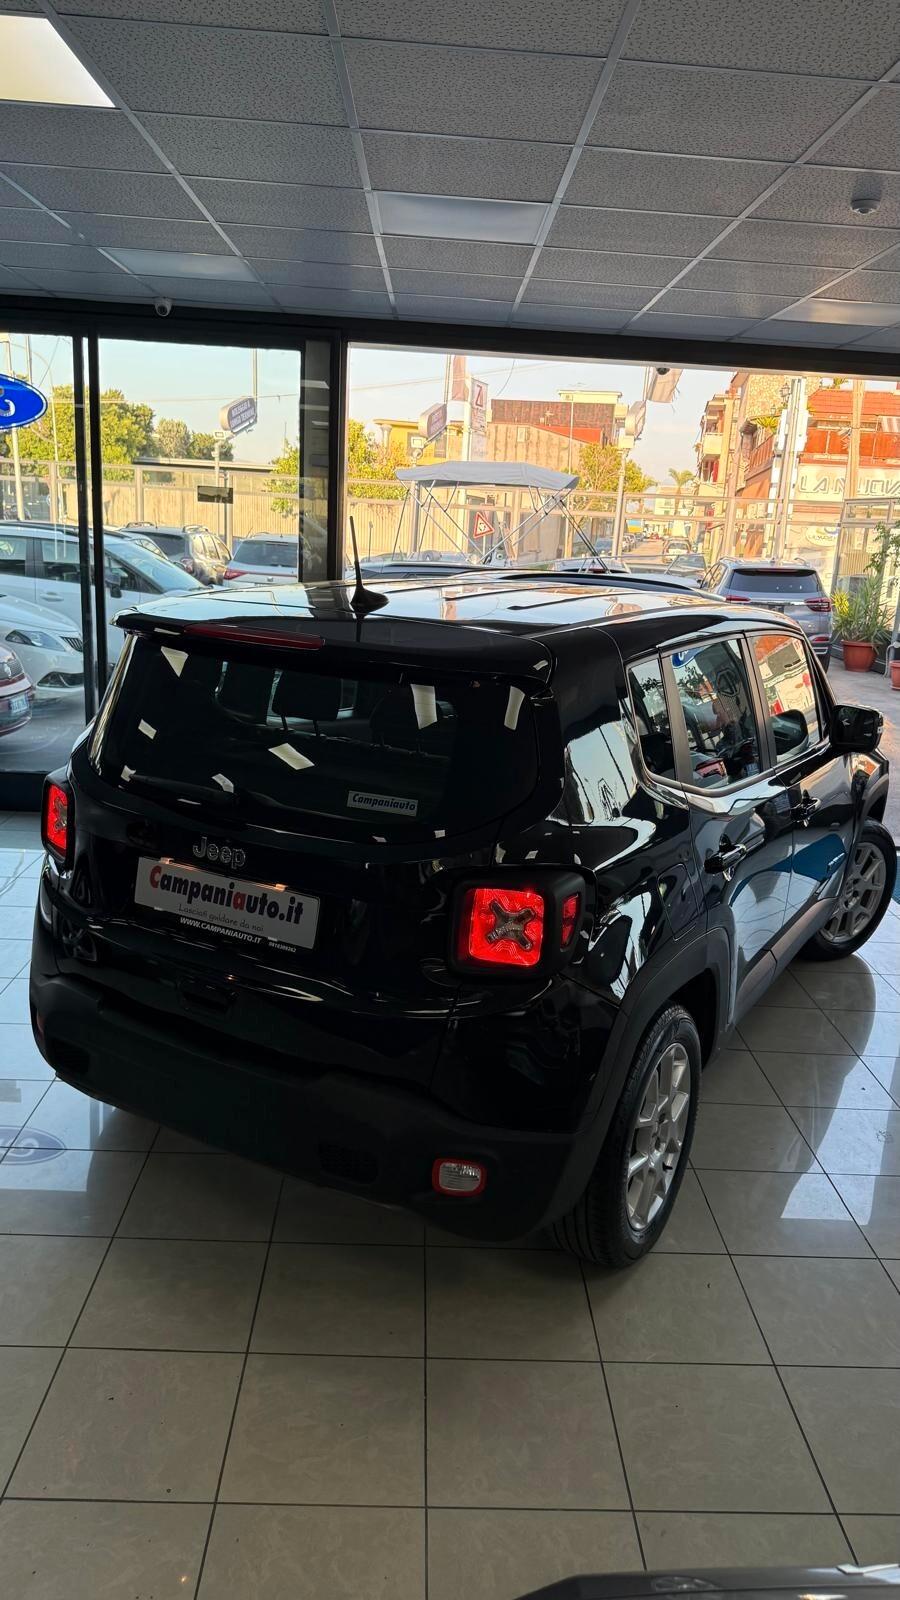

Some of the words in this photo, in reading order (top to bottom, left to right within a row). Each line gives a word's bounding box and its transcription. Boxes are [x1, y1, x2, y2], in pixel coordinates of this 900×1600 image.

[799, 475, 829, 494] LA
[352, 793, 416, 811] Campaniauto
[192, 836, 246, 869] Jeep
[149, 865, 303, 924] Campaniauto.it
[180, 917, 263, 944] WWW.CAMPANIAUTO.IT
[240, 919, 250, 929] da
[251, 924, 264, 932] noi
